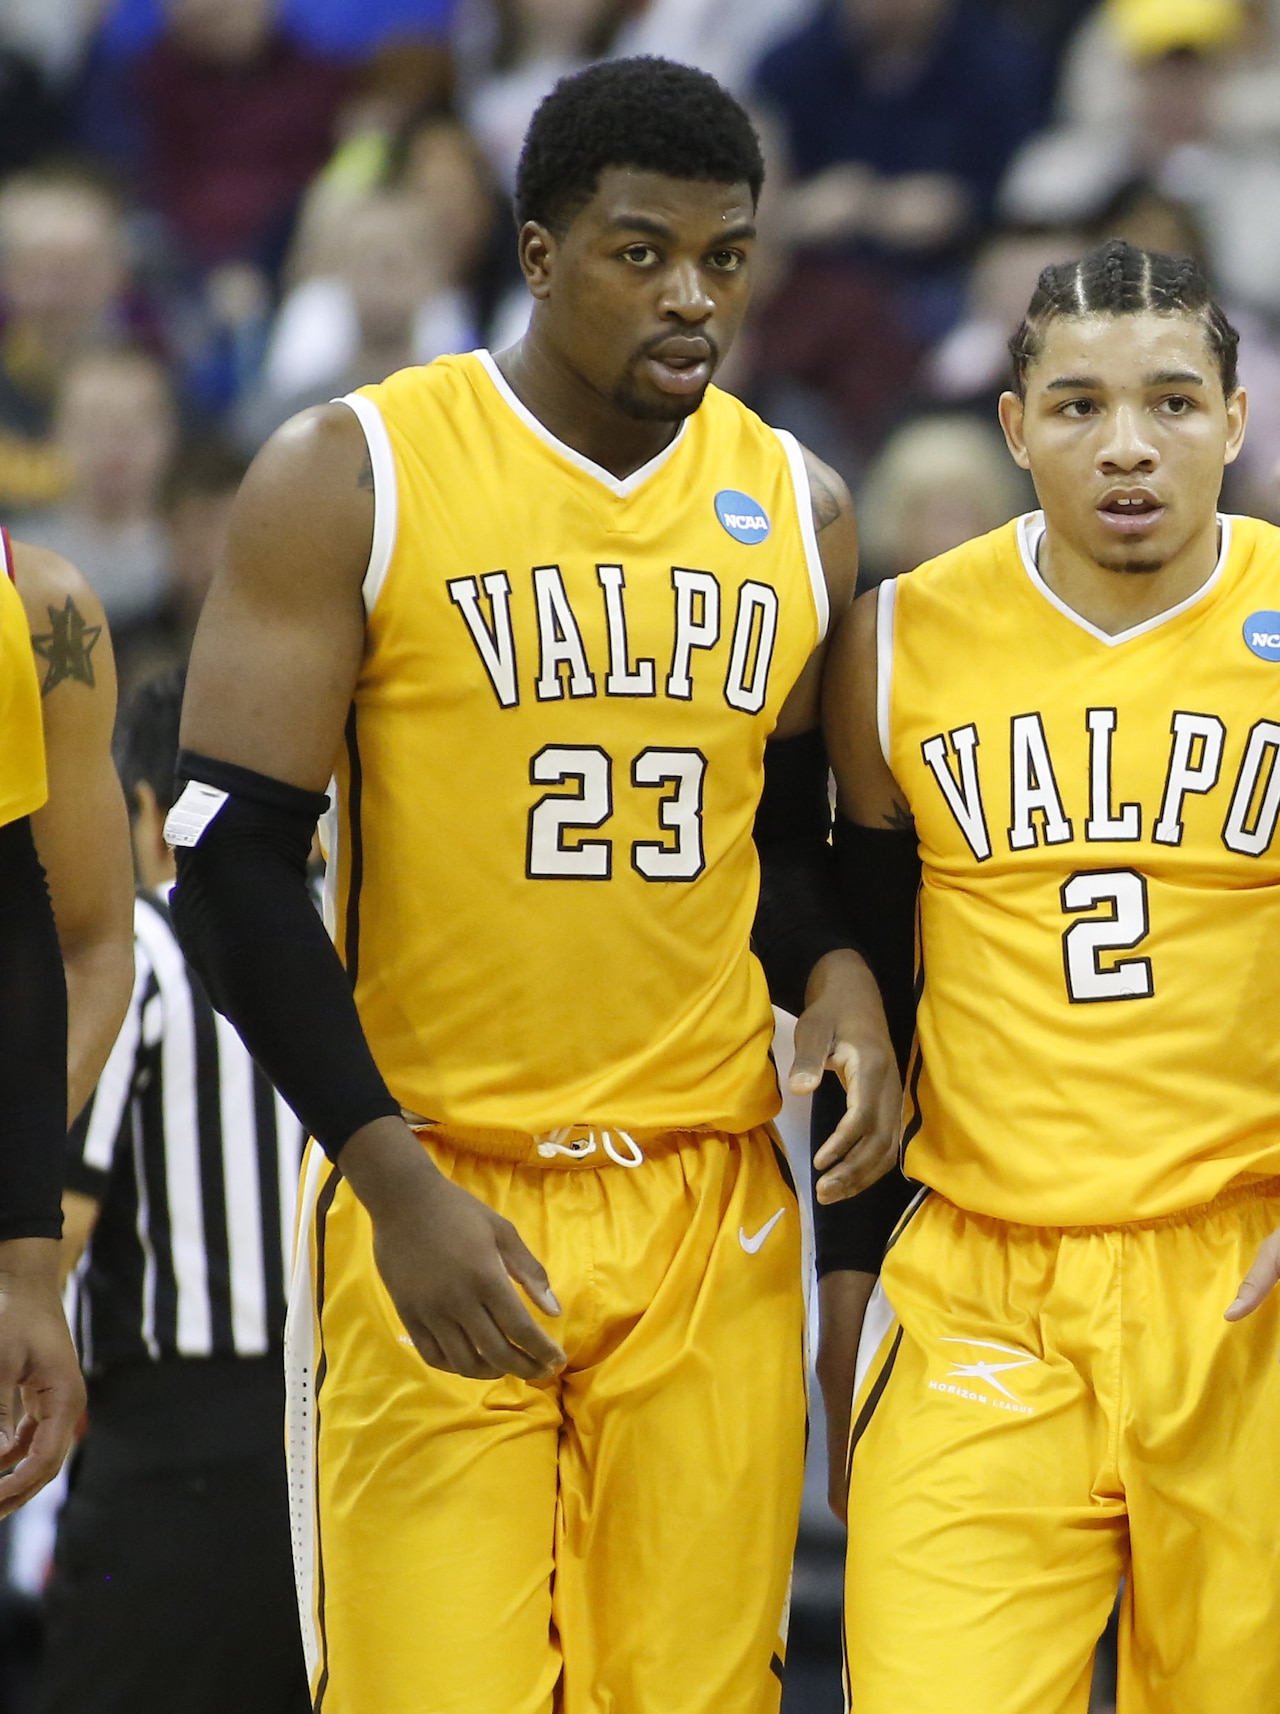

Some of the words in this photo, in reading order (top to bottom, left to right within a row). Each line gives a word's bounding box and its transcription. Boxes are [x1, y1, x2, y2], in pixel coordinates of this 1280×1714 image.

[723, 513, 768, 530] NCAA
[446, 564, 779, 716] VALPO
[526, 743, 708, 882] 23
[1059, 867, 1154, 1004] 2
[928, 1380, 988, 1403] HORIZON
[992, 1400, 1034, 1415] LEAGUE
